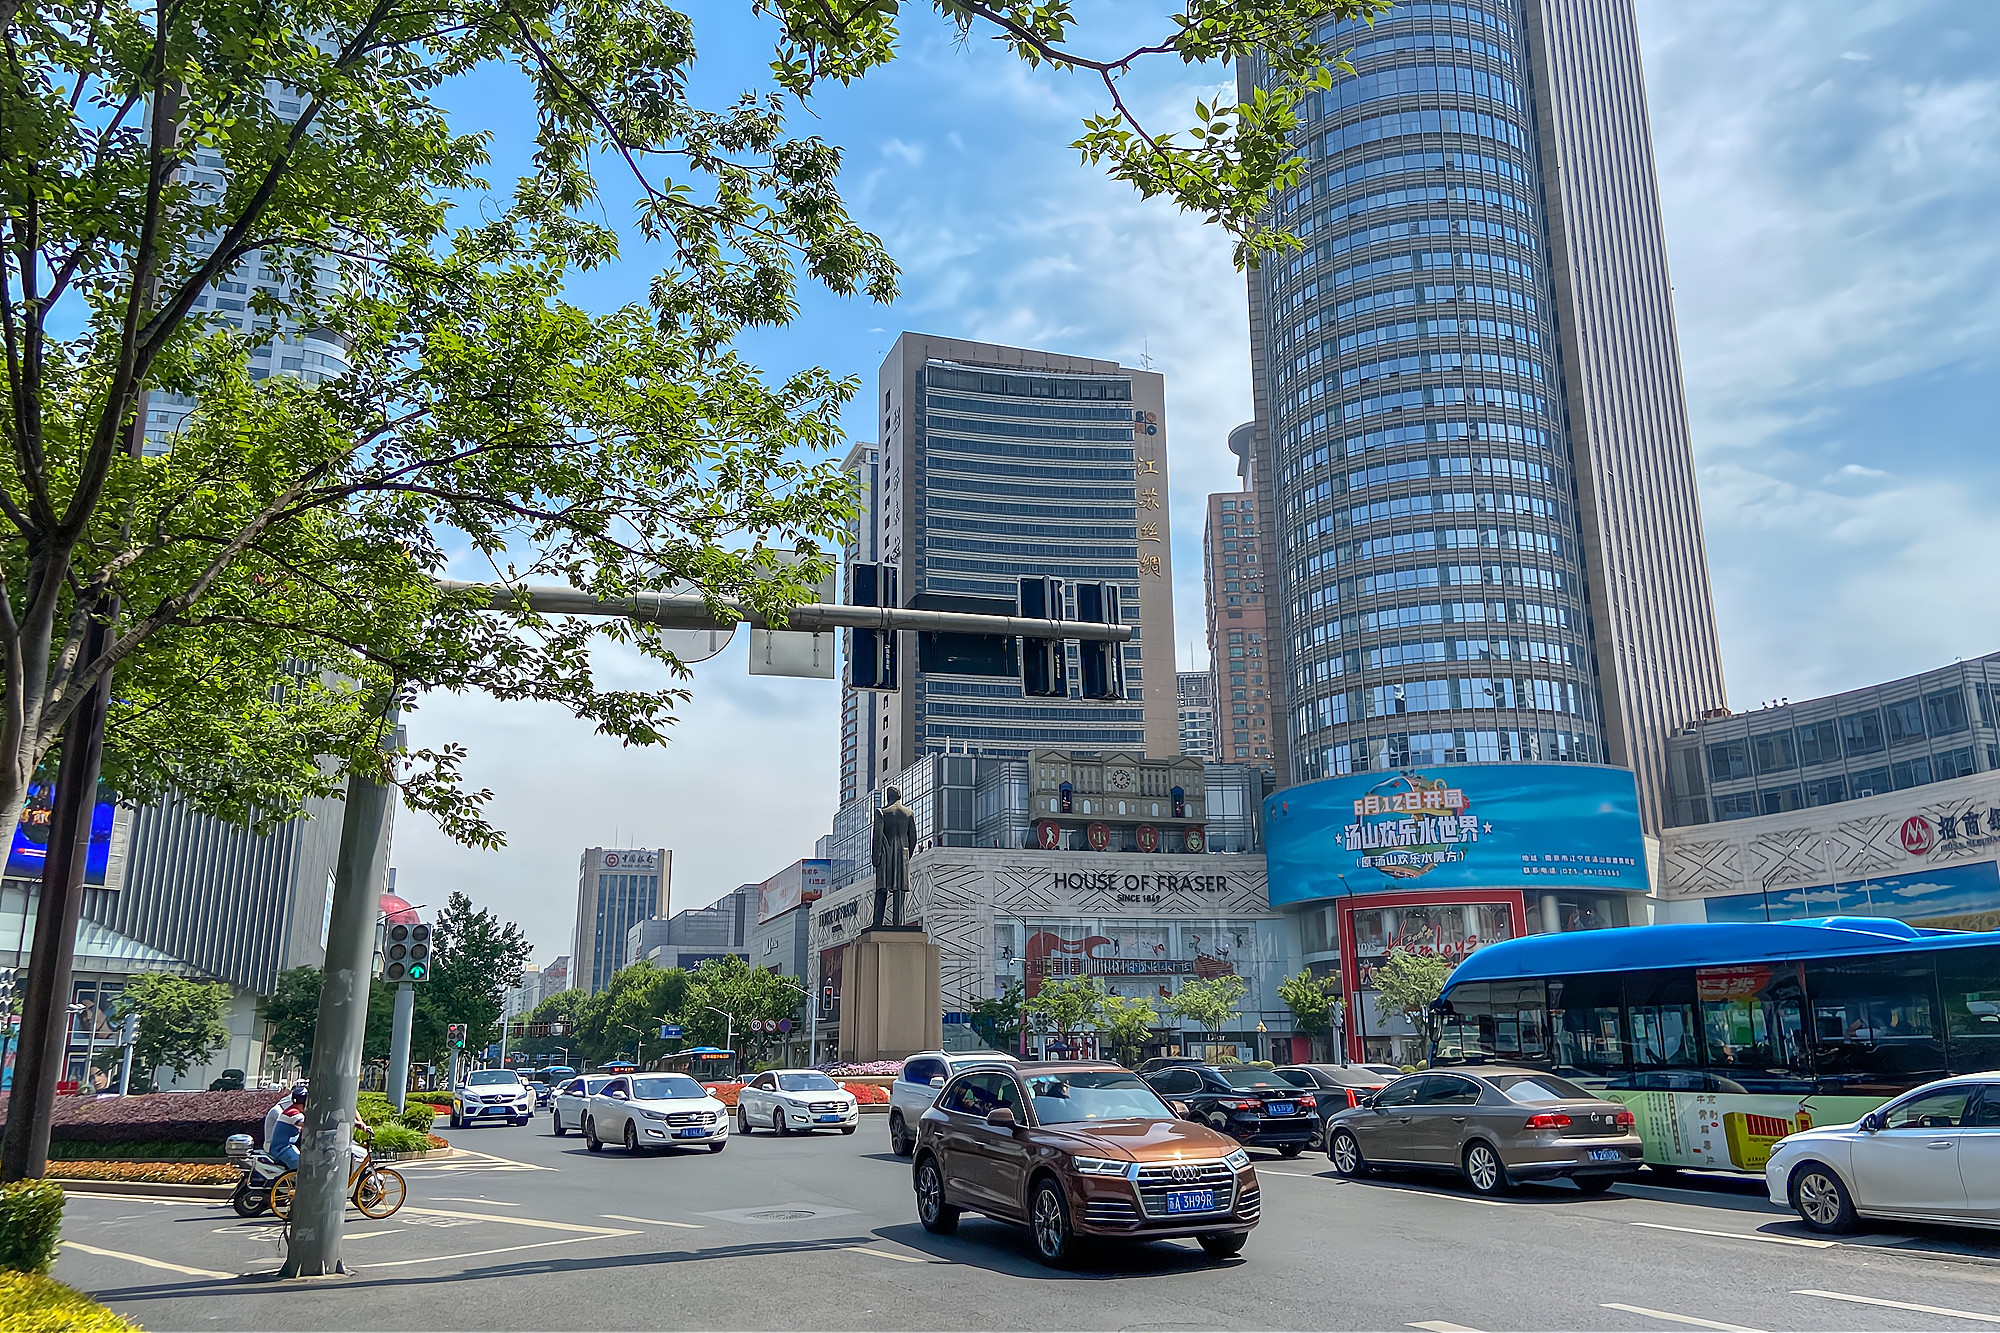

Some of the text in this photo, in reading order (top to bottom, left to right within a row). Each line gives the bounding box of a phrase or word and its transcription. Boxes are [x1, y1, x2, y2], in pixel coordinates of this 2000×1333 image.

[1137, 456, 1162, 577] 江苏丝绸
[1353, 789, 1463, 816] 6月12日开园
[1344, 815, 1479, 851] 汤山欢乐水世界
[1054, 872, 1228, 893] HOUSE OF FRASER
[1117, 894, 1161, 903] SINCE 1849
[1381, 920, 1478, 968] Hamleys
[752, 1021, 761, 1030] 60
[1207, 1033, 1226, 1041] Dor
[1183, 1194, 1213, 1209] 3H99R
